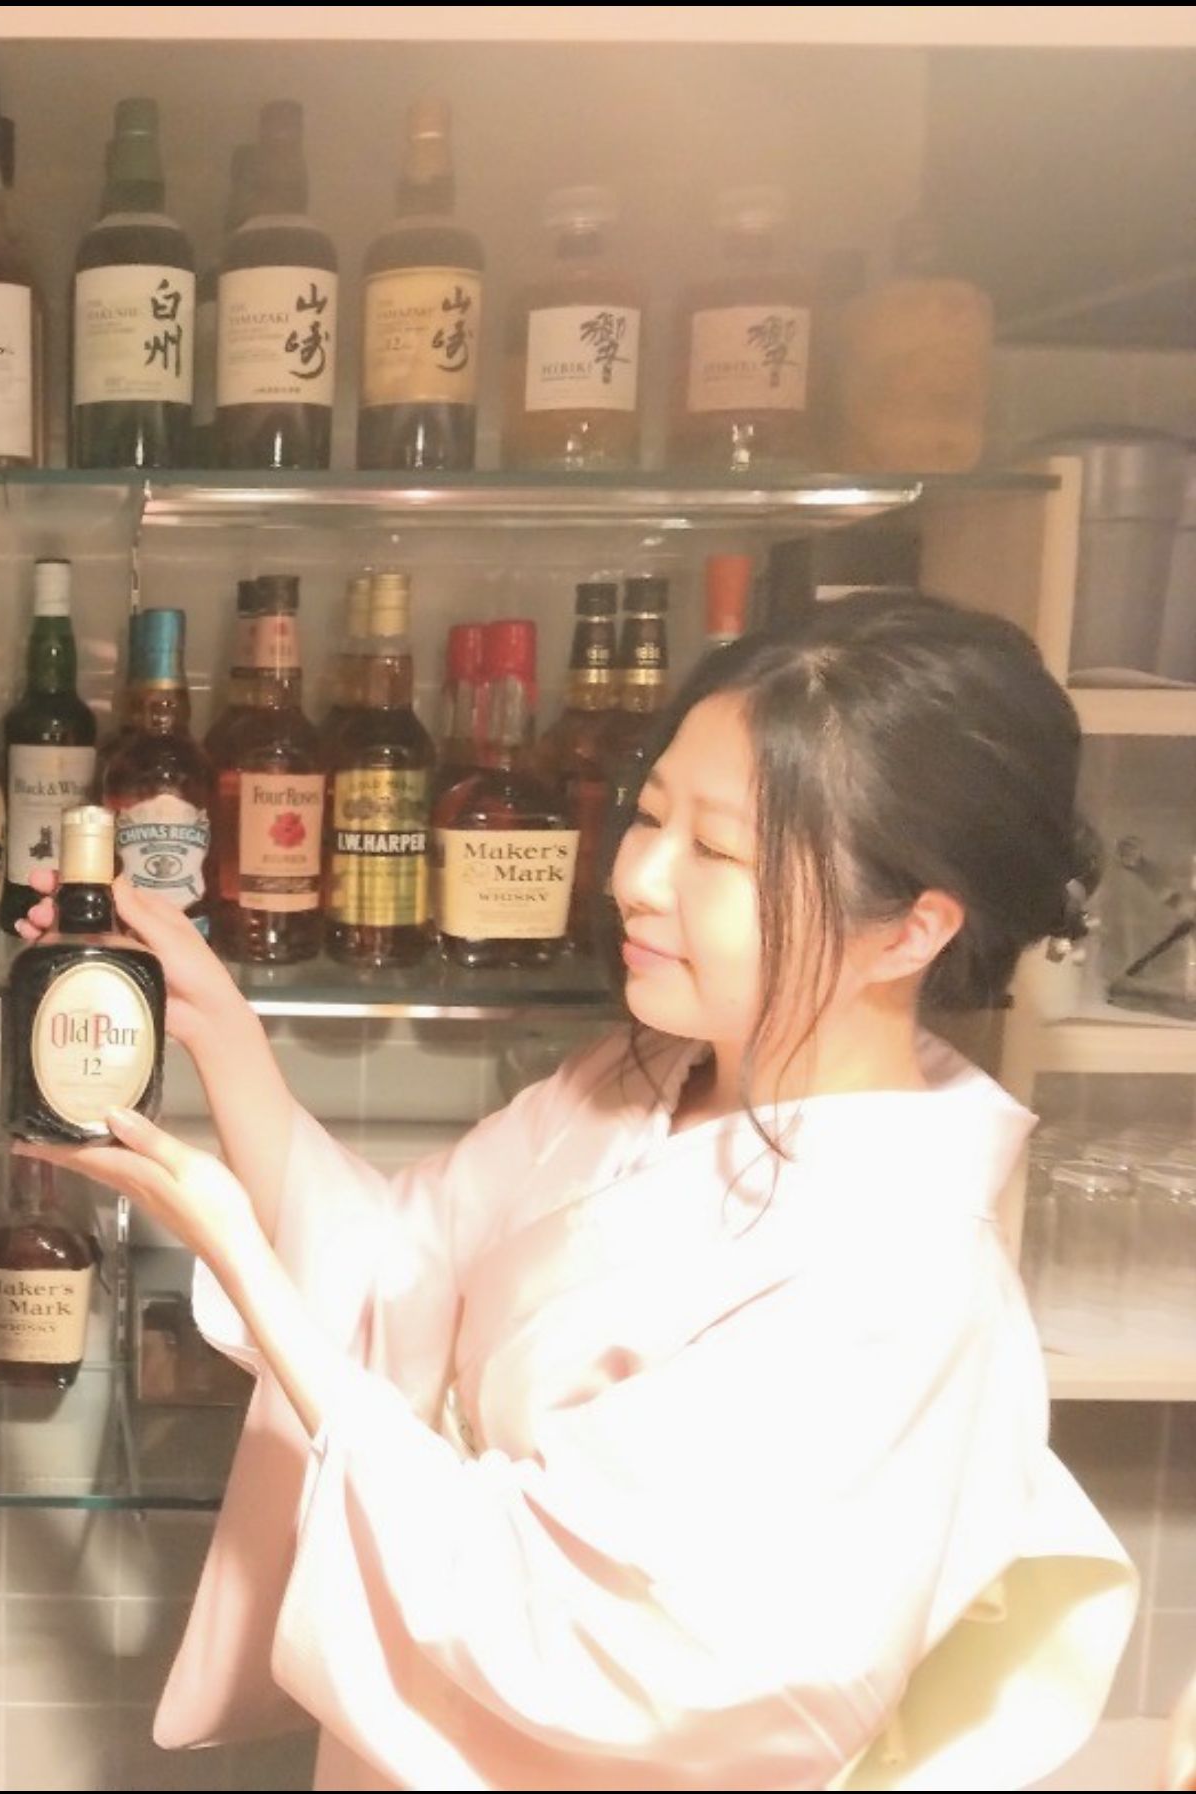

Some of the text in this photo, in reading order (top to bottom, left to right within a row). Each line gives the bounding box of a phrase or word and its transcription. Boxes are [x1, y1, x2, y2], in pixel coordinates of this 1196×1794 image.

[144, 279, 183, 379] 白州
[284, 283, 330, 380] 山崎
[432, 285, 474, 373] 山崎
[580, 311, 631, 385] 響
[747, 315, 800, 388] 響
[119, 825, 167, 845] CHIVAS
[464, 842, 568, 860] Maker's
[493, 865, 565, 882] Mark
[51, 1012, 139, 1050] Old Parr
[81, 1057, 102, 1076] 12
[9, 1302, 73, 1316] Mark
